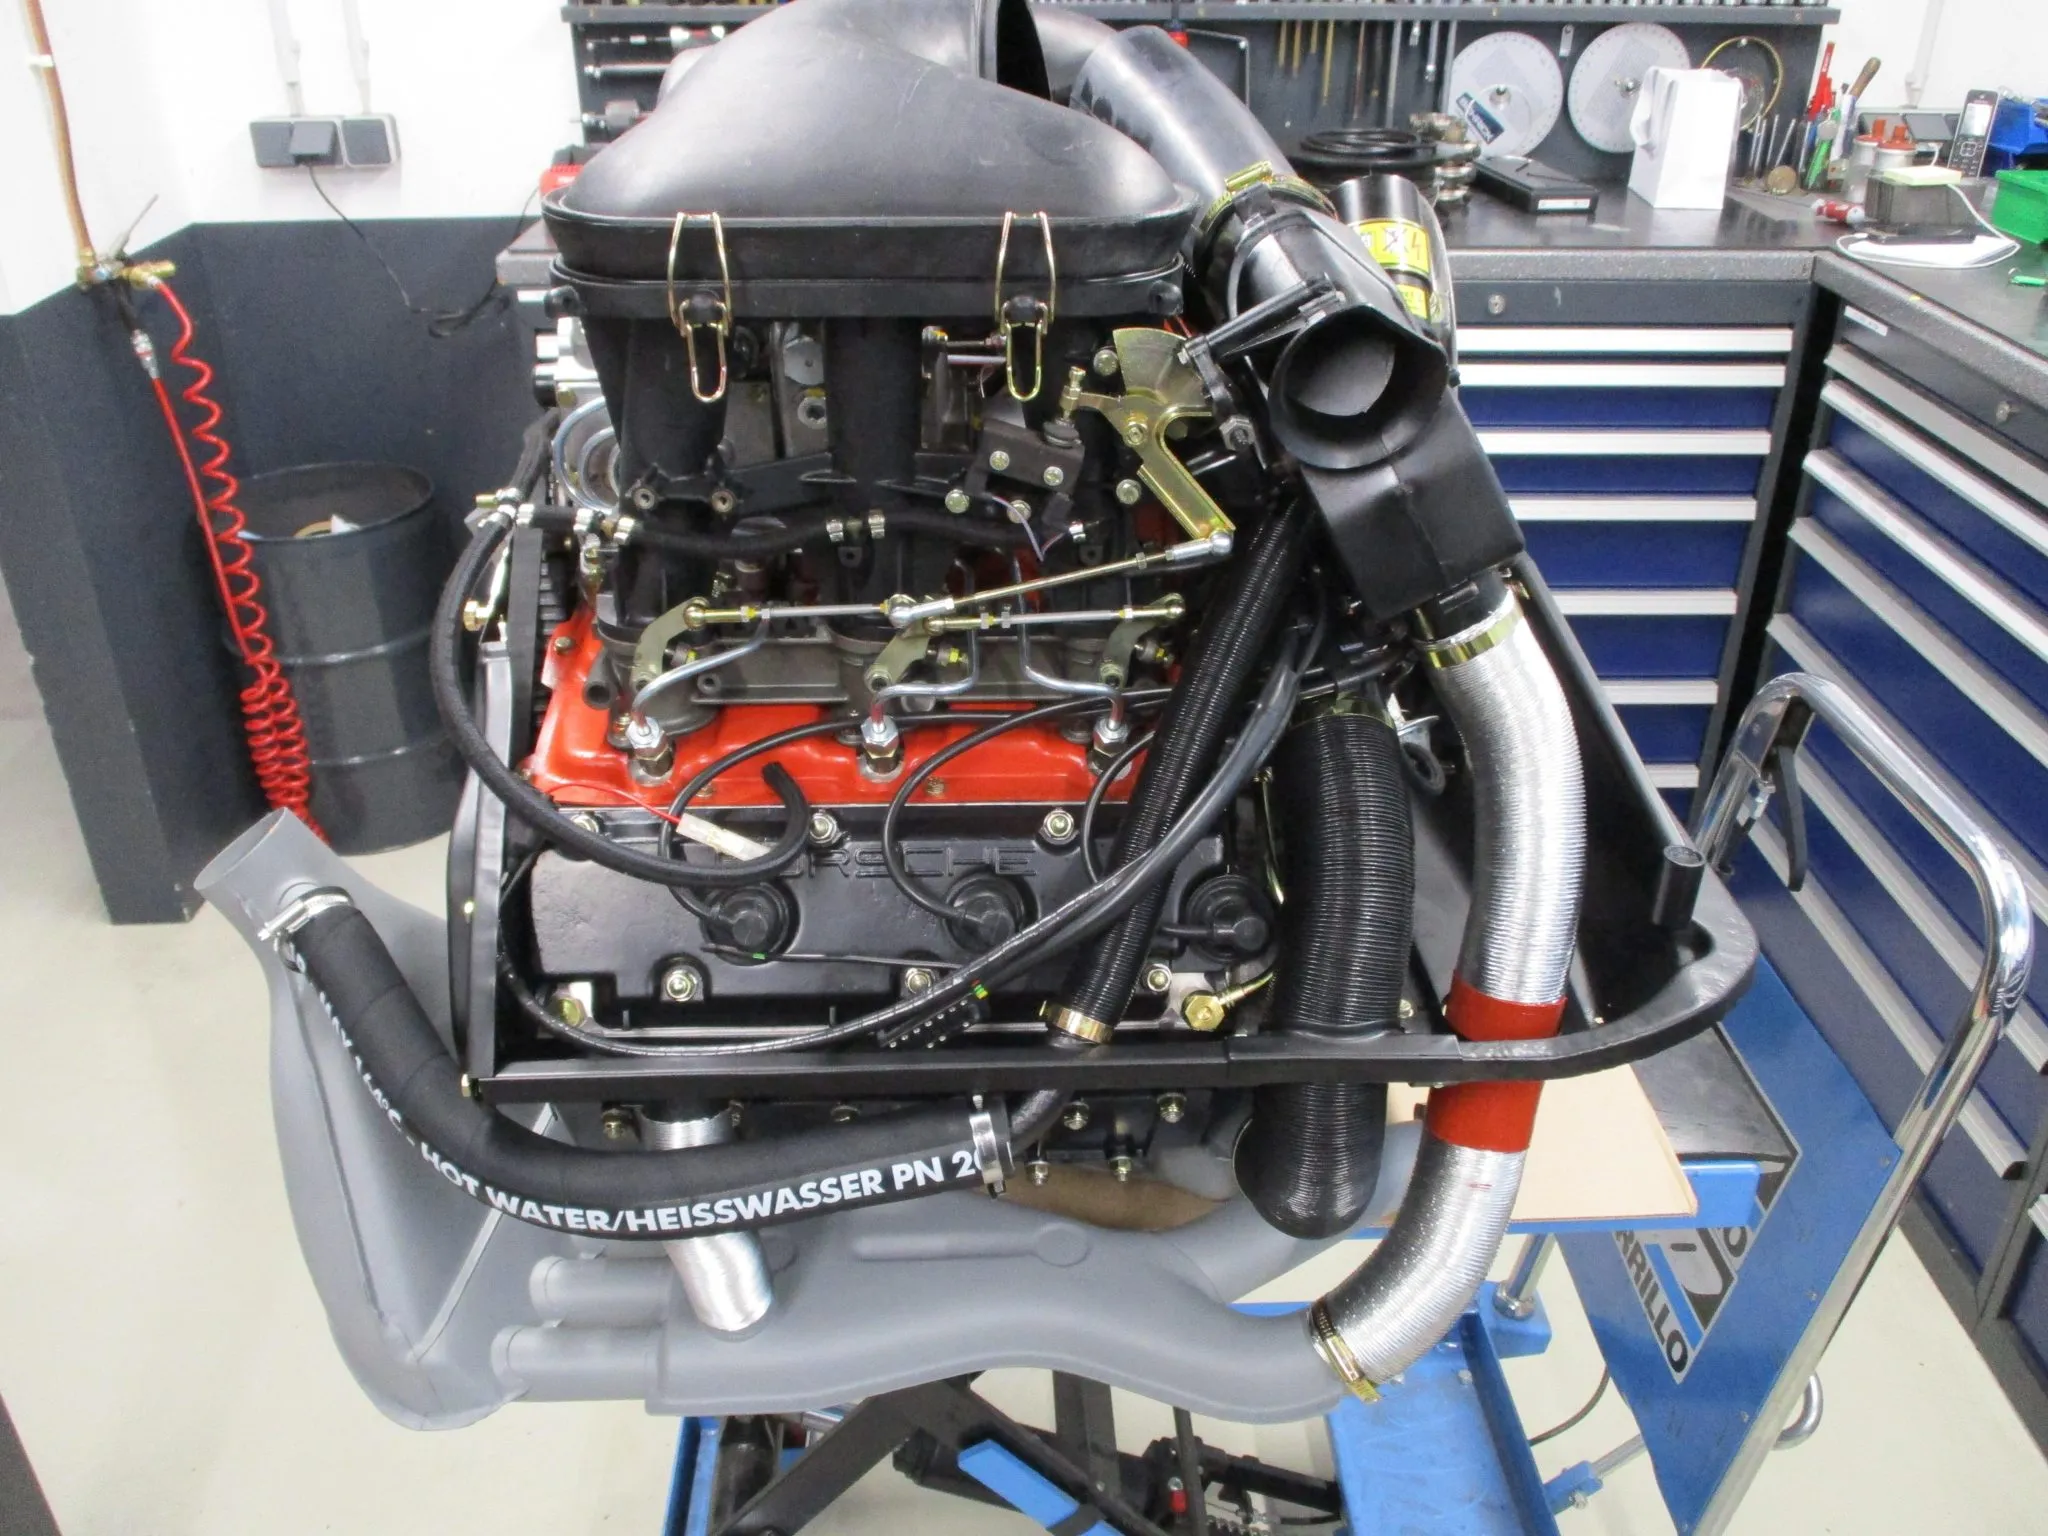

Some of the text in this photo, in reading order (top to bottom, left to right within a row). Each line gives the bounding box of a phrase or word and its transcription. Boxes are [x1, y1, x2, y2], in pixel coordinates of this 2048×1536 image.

[420, 1141, 480, 1197] HOT
[485, 1168, 886, 1232] WATER/HEISSWASSER
[891, 1156, 945, 1191] PN
